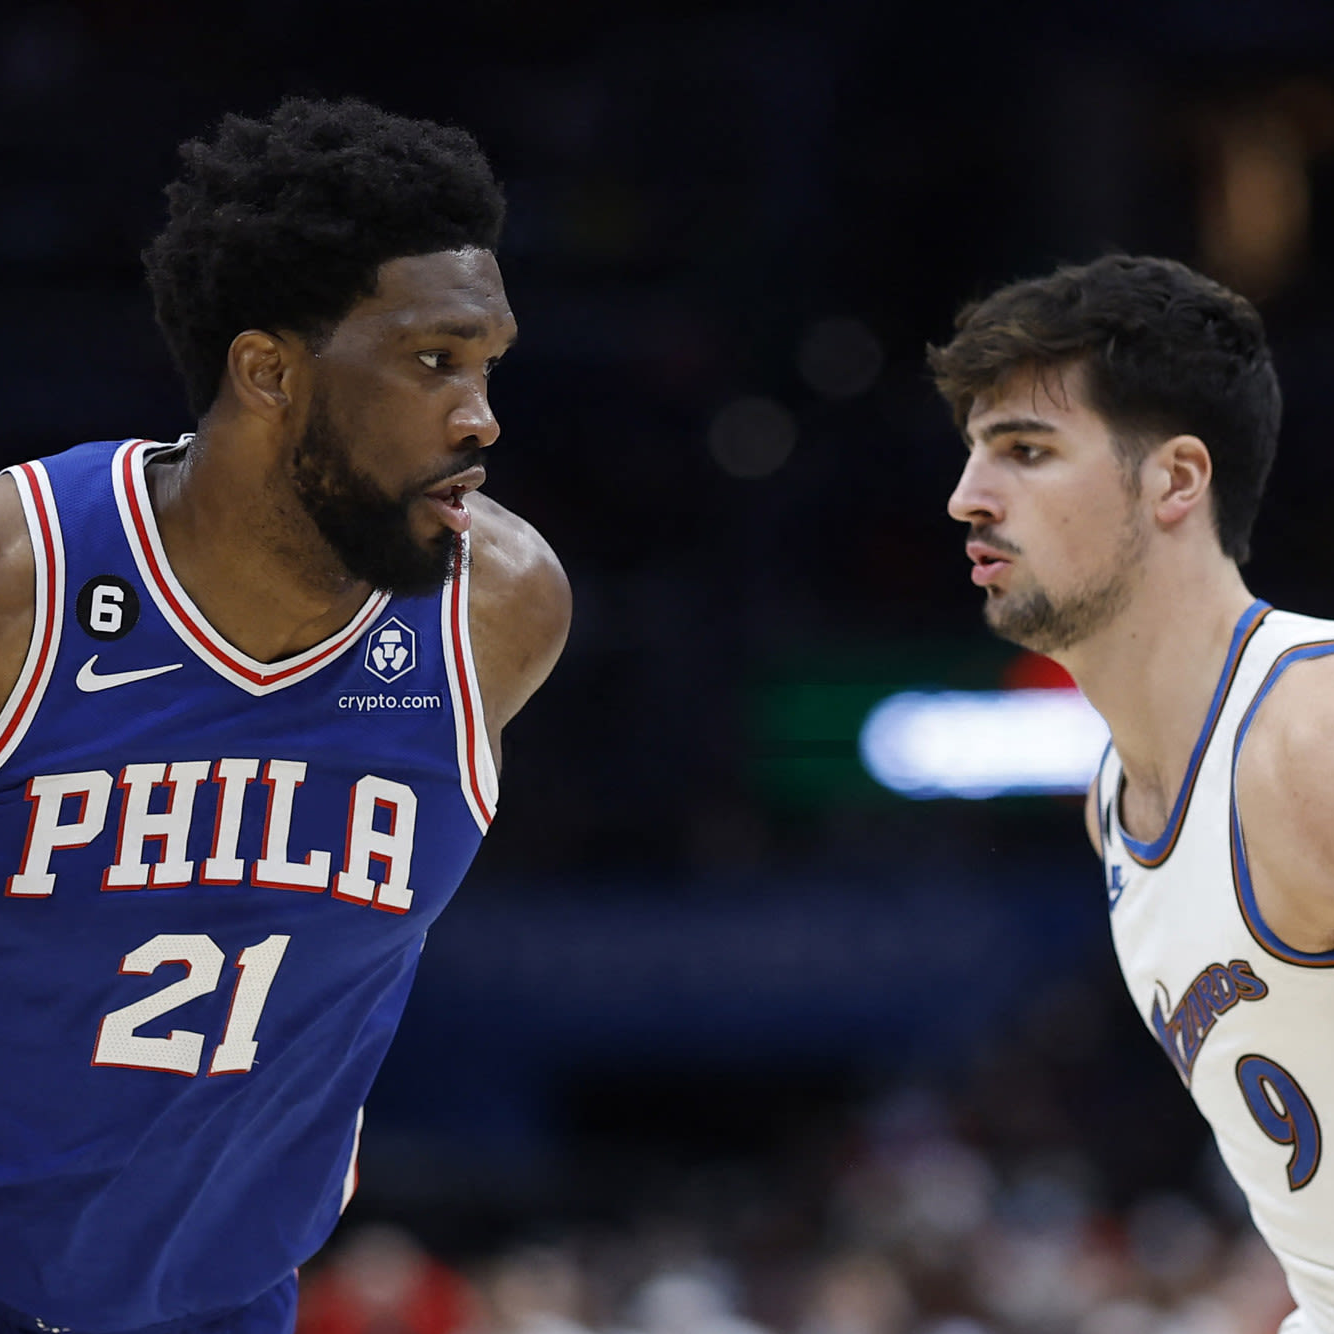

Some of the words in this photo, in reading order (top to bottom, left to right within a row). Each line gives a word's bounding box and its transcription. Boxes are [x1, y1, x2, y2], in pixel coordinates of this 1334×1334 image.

[89, 584, 126, 634] 6
[337, 690, 443, 714] crypto.com
[4, 757, 419, 916] PHILA
[91, 933, 292, 1078] 21
[1235, 1053, 1323, 1192] 9
